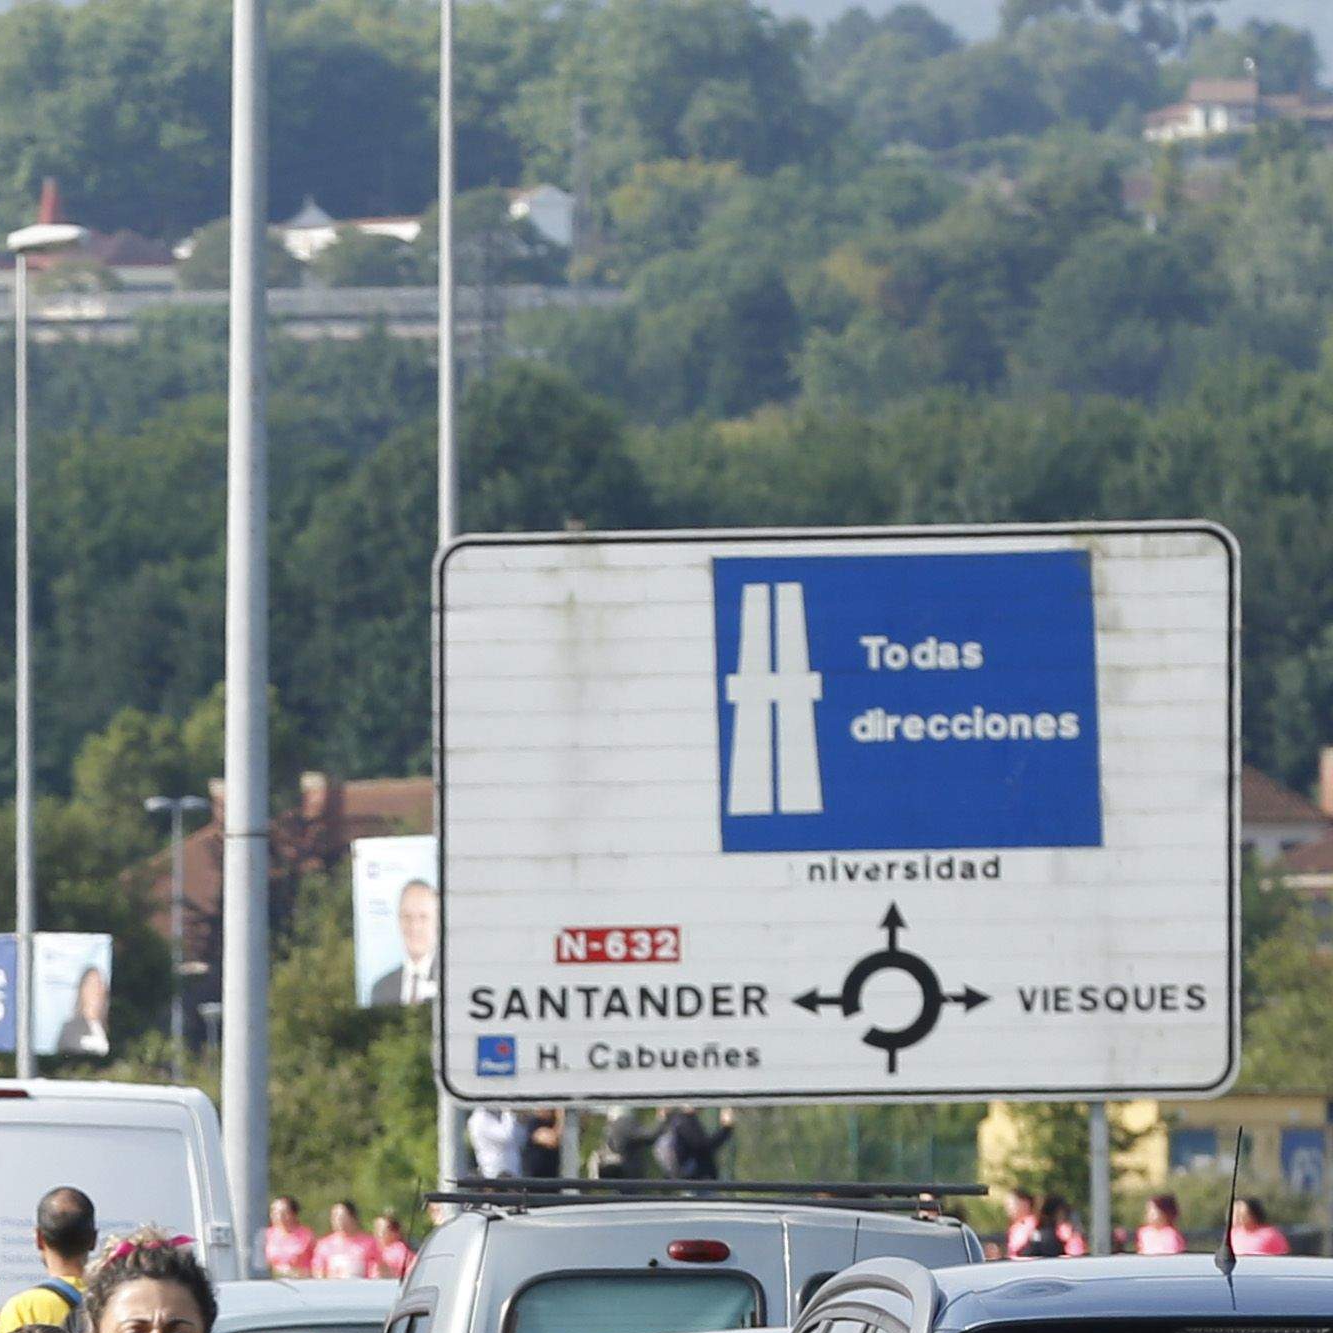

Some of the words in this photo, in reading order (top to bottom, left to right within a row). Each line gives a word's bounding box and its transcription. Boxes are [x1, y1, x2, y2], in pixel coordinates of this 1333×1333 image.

[859, 635, 984, 671] Todas
[850, 704, 1080, 742] direcciones
[559, 929, 679, 961] N-632
[469, 984, 769, 1021] SANTANDER
[1018, 984, 1208, 1013] VIESQUES
[536, 1045, 570, 1071] H.
[587, 1042, 763, 1070] Cabueñes
